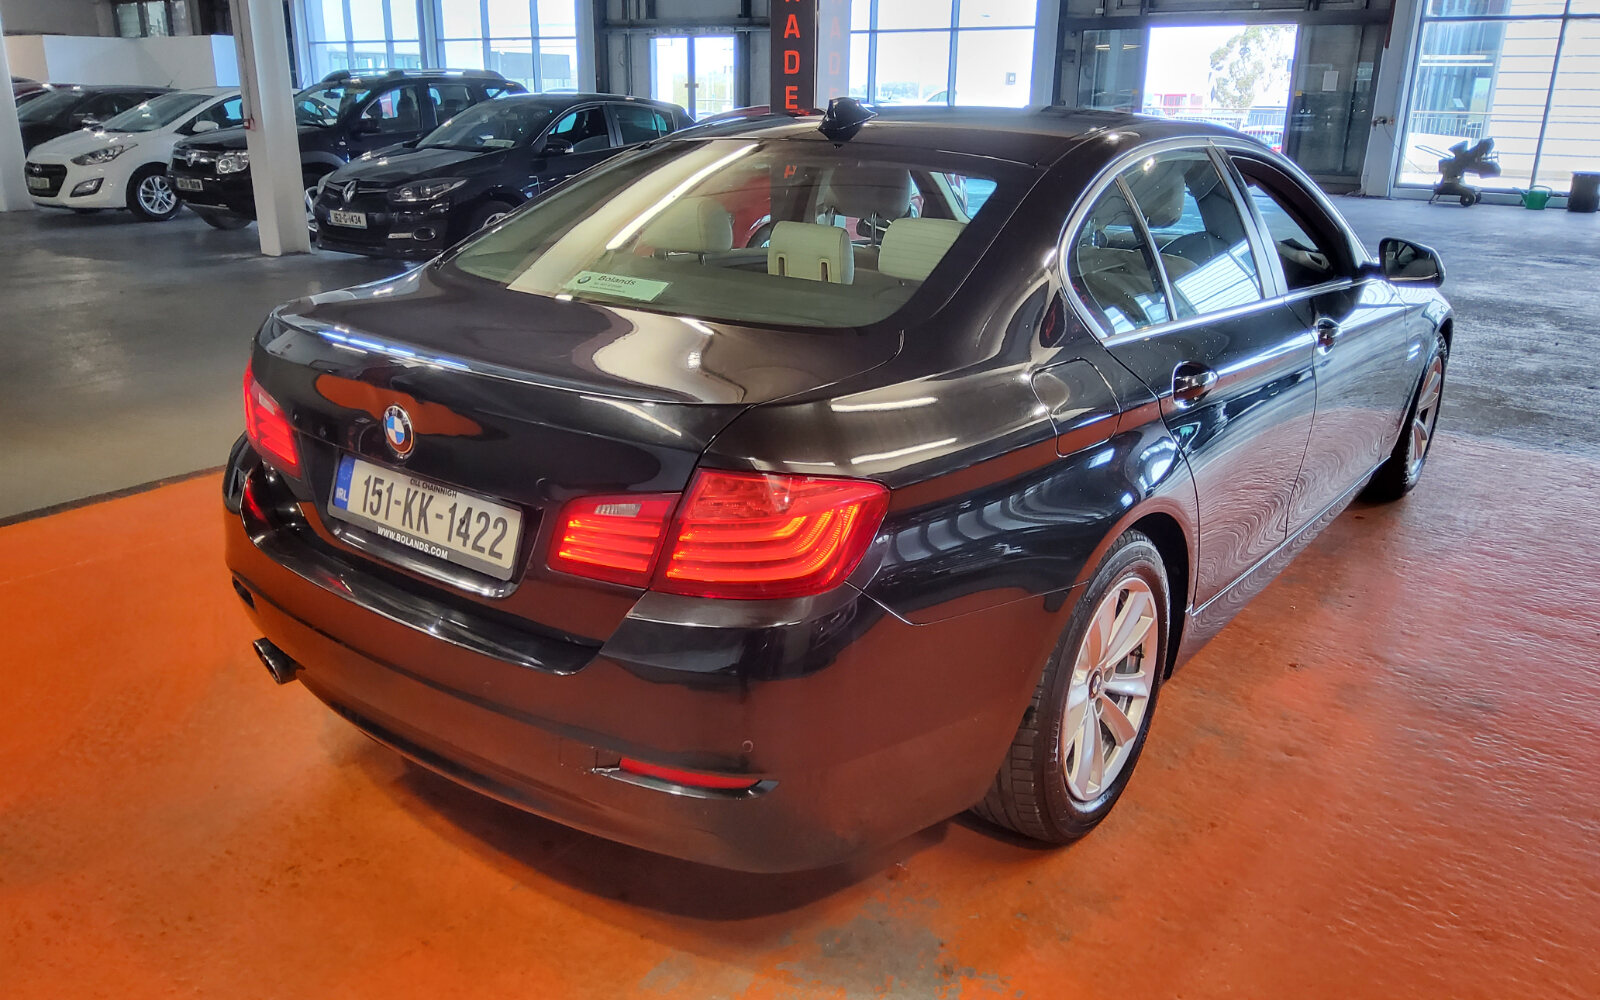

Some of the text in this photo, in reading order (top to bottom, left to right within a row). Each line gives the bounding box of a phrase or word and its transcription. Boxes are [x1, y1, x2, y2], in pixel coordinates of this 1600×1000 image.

[783, 0, 800, 109] ADE
[598, 275, 637, 286] Bolands
[335, 487, 348, 503] IRL
[362, 475, 508, 560] 151-KK-1422
[377, 526, 449, 559] WWW.BOLANDS.COM
